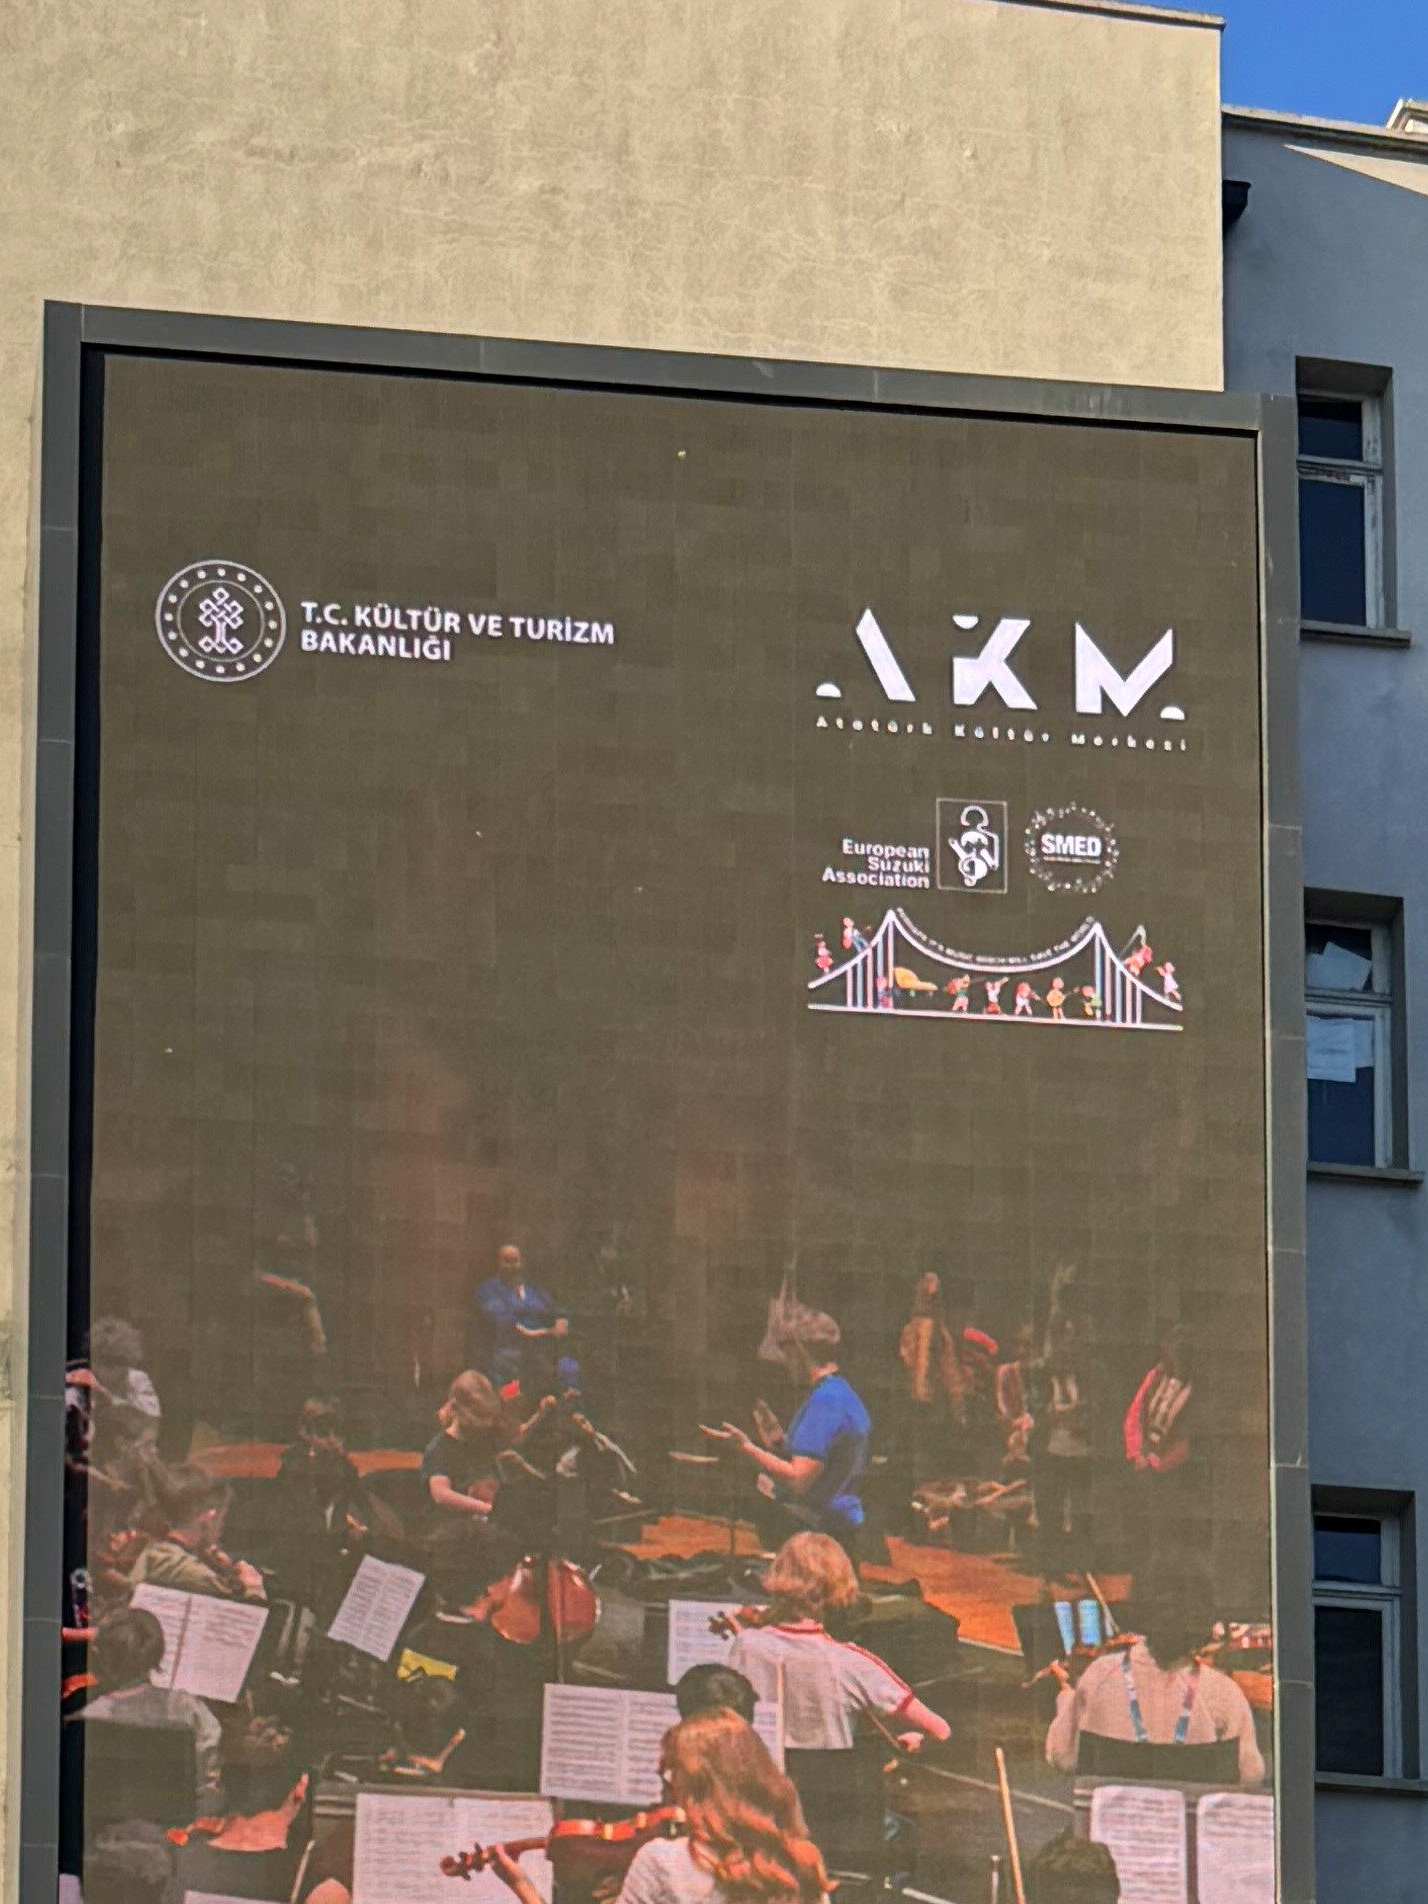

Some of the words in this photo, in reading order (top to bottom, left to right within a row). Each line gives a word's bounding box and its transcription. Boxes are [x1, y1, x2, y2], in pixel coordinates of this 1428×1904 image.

[301, 602, 348, 626] T.C.
[355, 603, 460, 634] KÜLTÜR
[468, 613, 503, 637] VE
[510, 616, 615, 645] TURİZM
[301, 630, 451, 661] BAKANLIĞI
[842, 839, 930, 858] European
[1041, 834, 1102, 856] SMED
[868, 856, 930, 873] Suzuki
[822, 867, 930, 889] Association
